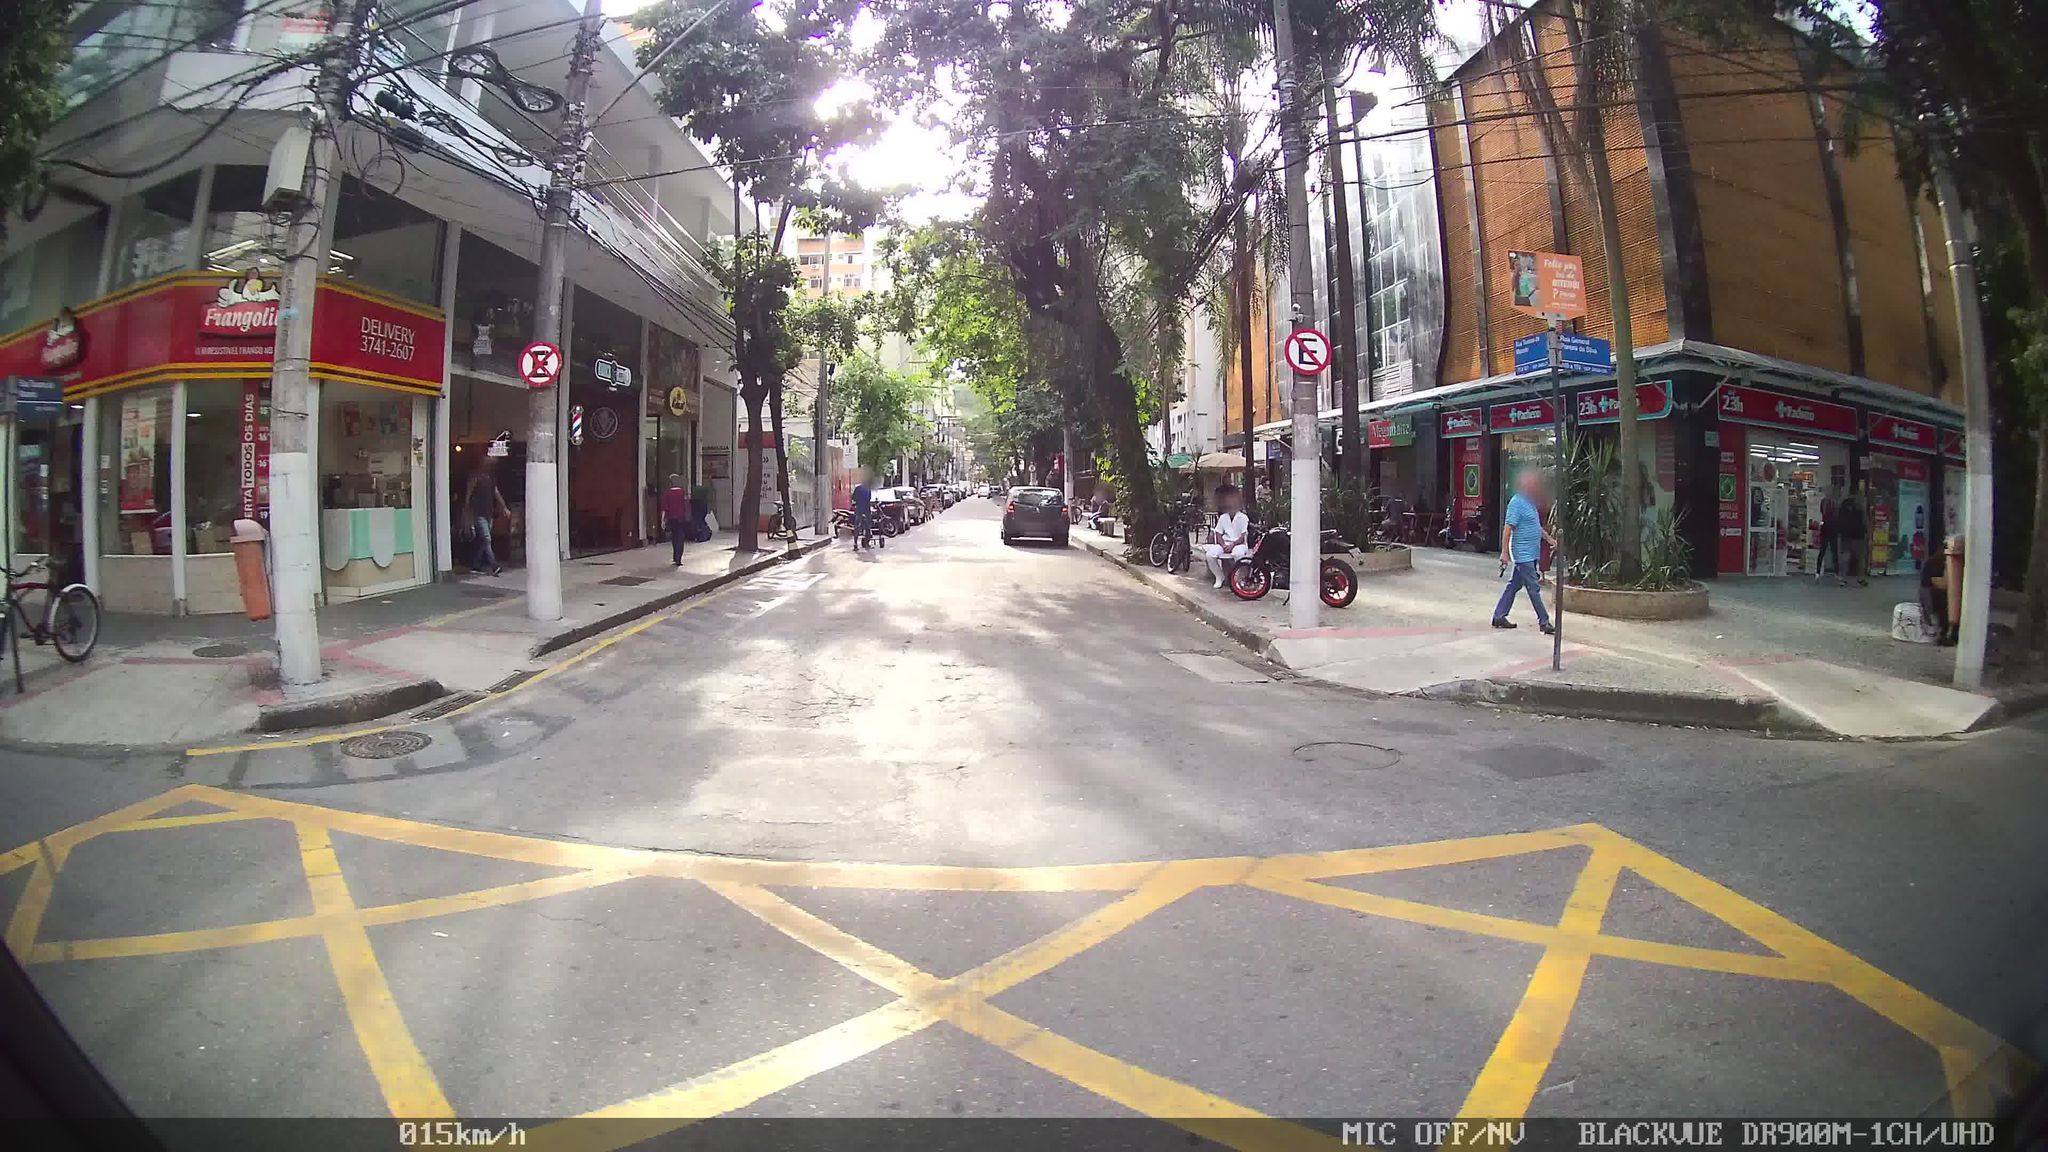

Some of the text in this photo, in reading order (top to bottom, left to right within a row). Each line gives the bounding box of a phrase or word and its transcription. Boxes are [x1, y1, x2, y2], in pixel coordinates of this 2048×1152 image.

[205, 307, 278, 332] Frangoli
[361, 316, 415, 345] DELIVERY
[360, 336, 415, 361] 3741-2607
[1560, 334, 1570, 343] Rua
[1580, 400, 1597, 415] 23h
[244, 393, 255, 518] ERTA TODOS OS DIAS
